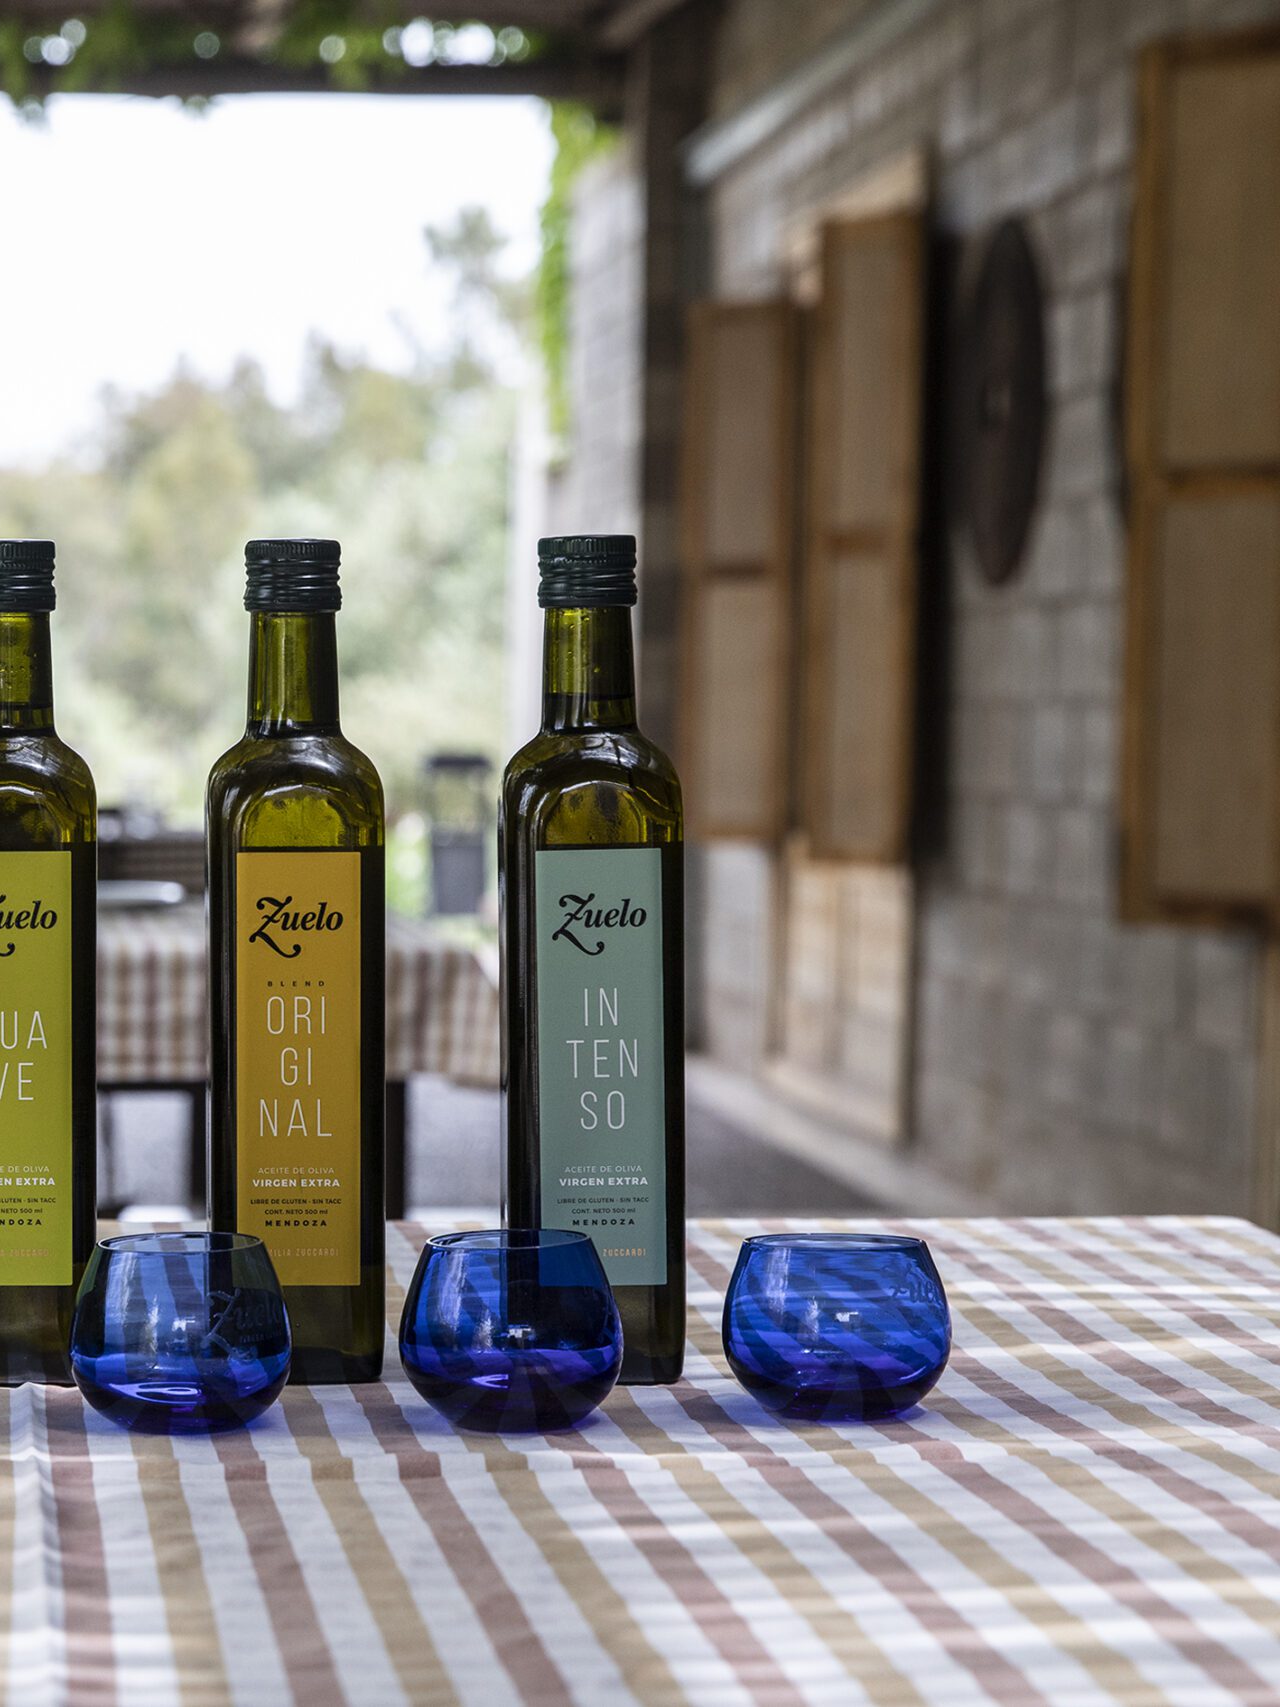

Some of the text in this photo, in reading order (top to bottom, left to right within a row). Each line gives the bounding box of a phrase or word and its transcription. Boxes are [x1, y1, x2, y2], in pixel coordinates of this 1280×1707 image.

[248, 895, 344, 959] Zuelo
[552, 892, 647, 956] Zuelo
[584, 987, 618, 1026] IN
[266, 996, 326, 1035] ORI
[566, 1038, 638, 1078] TEN
[280, 1047, 312, 1086] GI
[580, 1090, 626, 1130] SO
[259, 1098, 333, 1137] NAL
[7, 1165, 20, 1174] DE
[22, 1165, 50, 1174] OLIVA
[258, 1167, 335, 1175] ACEITE DE OLIVA
[564, 1165, 642, 1174] ACEITE DE OLIVA
[15, 1177, 56, 1186] EXTRA
[252, 1179, 341, 1188] VIRGEN EXTRA
[559, 1176, 649, 1187] VIRGEN EXTRA
[572, 1218, 636, 1227] MENDOZA
[295, 1248, 339, 1257] ZUCCARDI
[602, 1247, 647, 1257] ZUCCARDI
